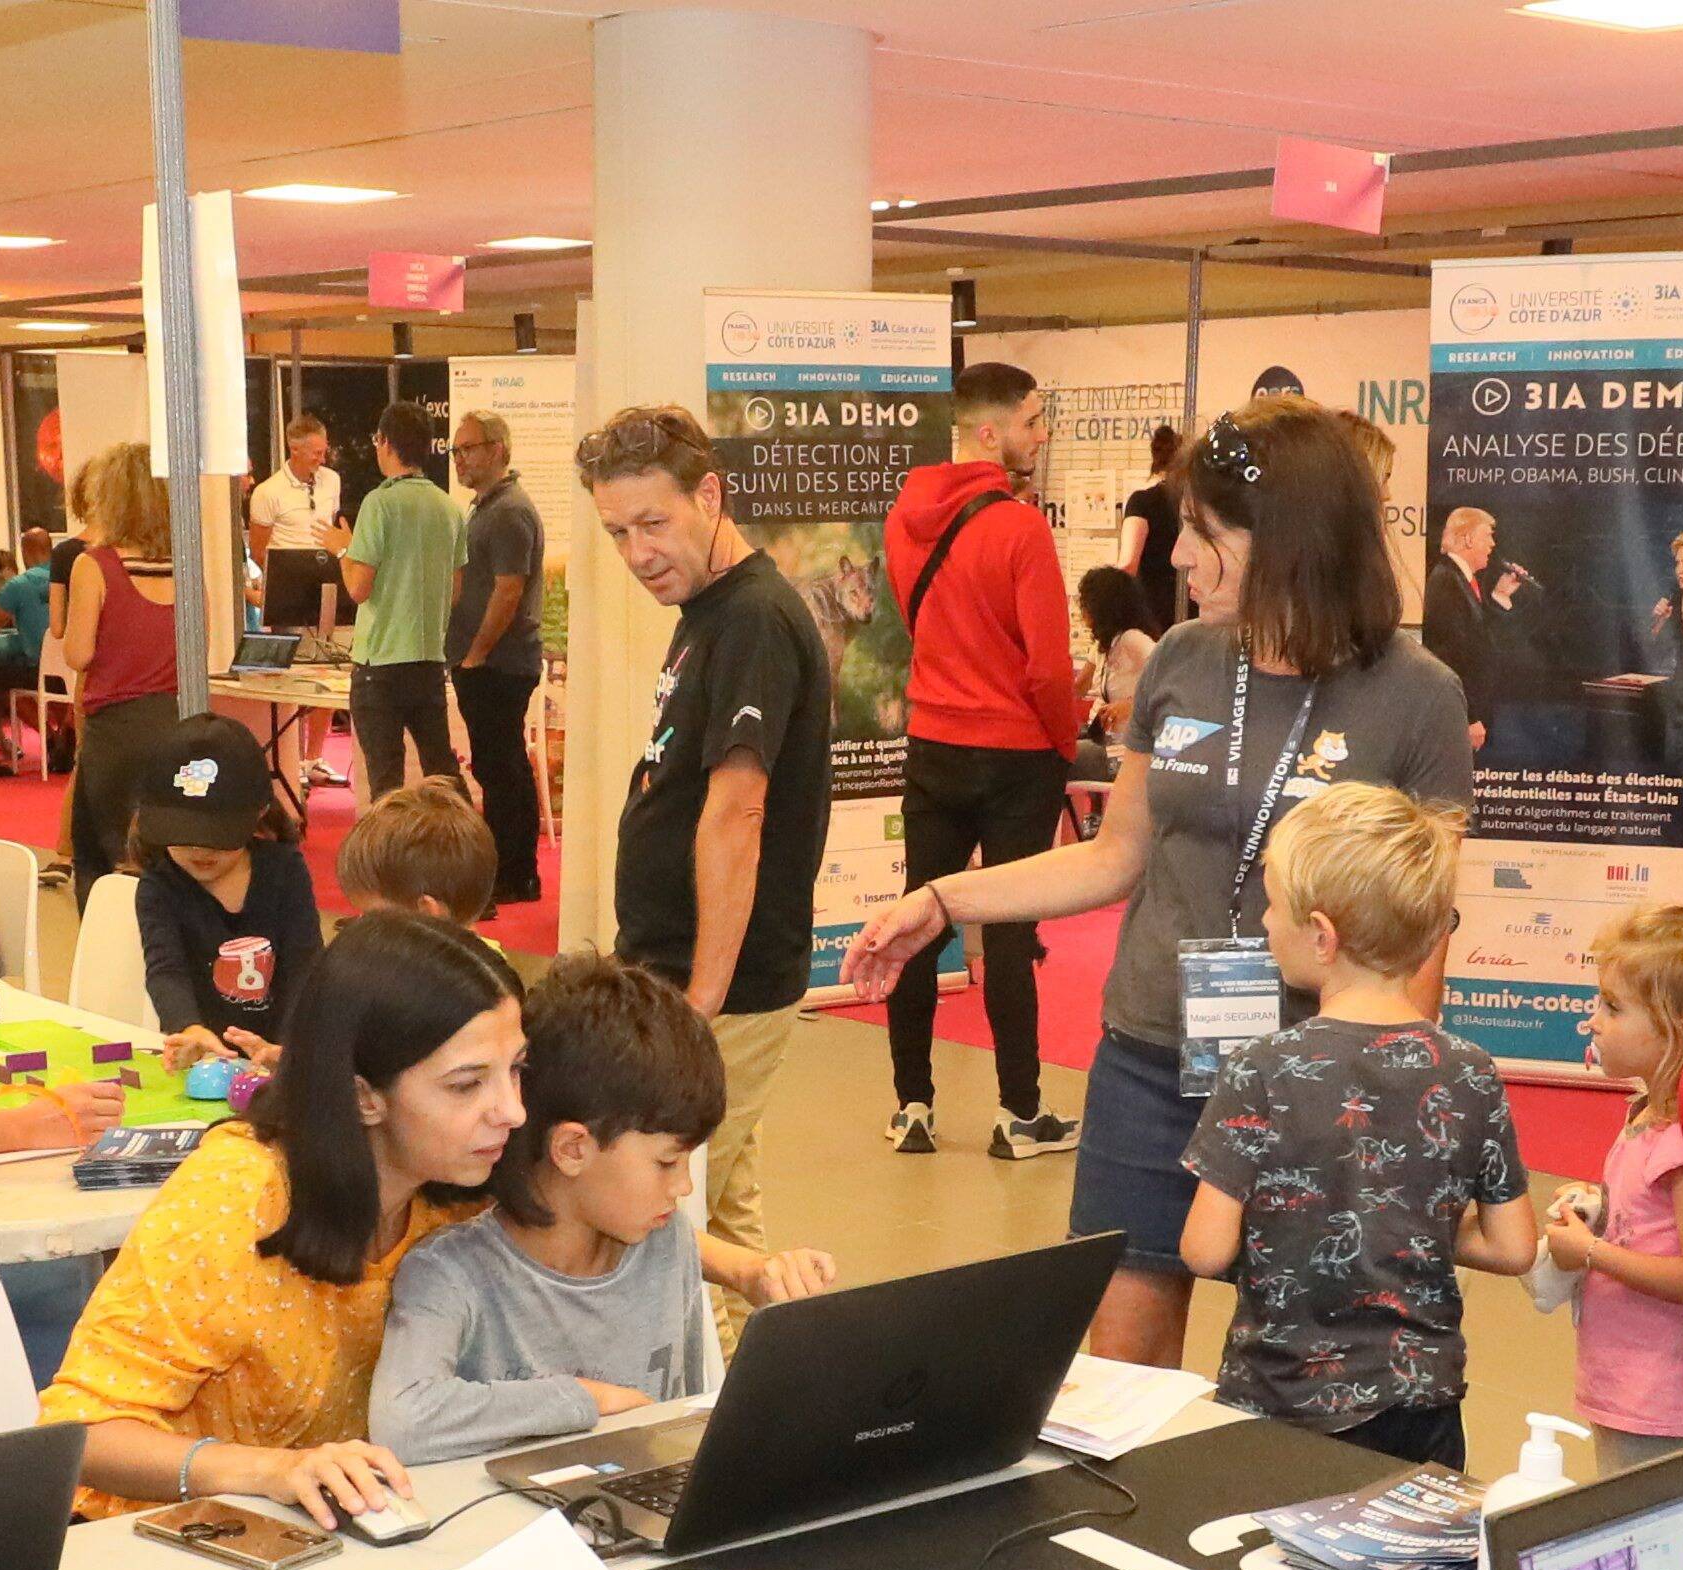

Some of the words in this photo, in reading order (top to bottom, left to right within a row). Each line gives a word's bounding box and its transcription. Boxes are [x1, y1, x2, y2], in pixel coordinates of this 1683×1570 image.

[1511, 288, 1601, 307] UNIVERSITÉ
[1509, 308, 1546, 323] CÔTE
[1549, 308, 1602, 323] D'AZUR
[767, 319, 835, 335] UNIVERSITÉ
[767, 335, 795, 349] CÔTE
[798, 335, 836, 349] D'AZUR
[1448, 351, 1516, 363] RESEARCH
[1548, 348, 1634, 361] INNOVATION
[722, 372, 777, 382] RESEARCH
[798, 373, 861, 382] INNOVATION
[881, 374, 939, 384] EDUCATION
[1076, 383, 1183, 411] UNIVERSIT
[1359, 379, 1430, 425] INR
[1525, 382, 1586, 410] 3IA
[784, 402, 831, 426] 3IA
[841, 402, 920, 427] DEMO
[1075, 414, 1122, 441] CÔTE
[753, 438, 880, 466] DÉTECTION
[889, 445, 914, 466] ET
[1442, 433, 1565, 458] ANALYSE
[1575, 432, 1628, 457] DES
[726, 472, 788, 495] SUIVI
[796, 471, 838, 492] DES
[1447, 468, 1506, 485] TRUMP,
[1511, 467, 1583, 485] OBAMA,
[1588, 468, 1639, 485] BUSH,
[753, 501, 792, 517] DANS
[797, 502, 813, 516] LE
[1235, 663, 1249, 694] DES
[1229, 695, 1245, 762] VILLAGE
[863, 739, 874, 750] et
[850, 751, 857, 764] à
[859, 754, 872, 764] un
[1166, 757, 1209, 775] France
[1523, 769, 1543, 783] les
[1546, 769, 1593, 784] débats
[1596, 772, 1622, 785] des
[1575, 789, 1601, 803] aux
[1604, 788, 1679, 805] États-Unis
[1235, 863, 1250, 883] DE
[1243, 751, 1294, 862] L'INNOVATION
[1482, 803, 1512, 816] l'aide
[1514, 804, 1591, 820] d'algorithmes
[1593, 808, 1608, 820] de
[1611, 810, 1672, 822] traitement
[1481, 819, 1553, 833] automatique
[1556, 821, 1571, 832] du
[1573, 822, 1617, 837] langage
[1619, 824, 1662, 837] naturel
[864, 893, 898, 904] Inserm
[1505, 924, 1573, 936] EURECOM
[1223, 1012, 1276, 1023] SEGURAN
